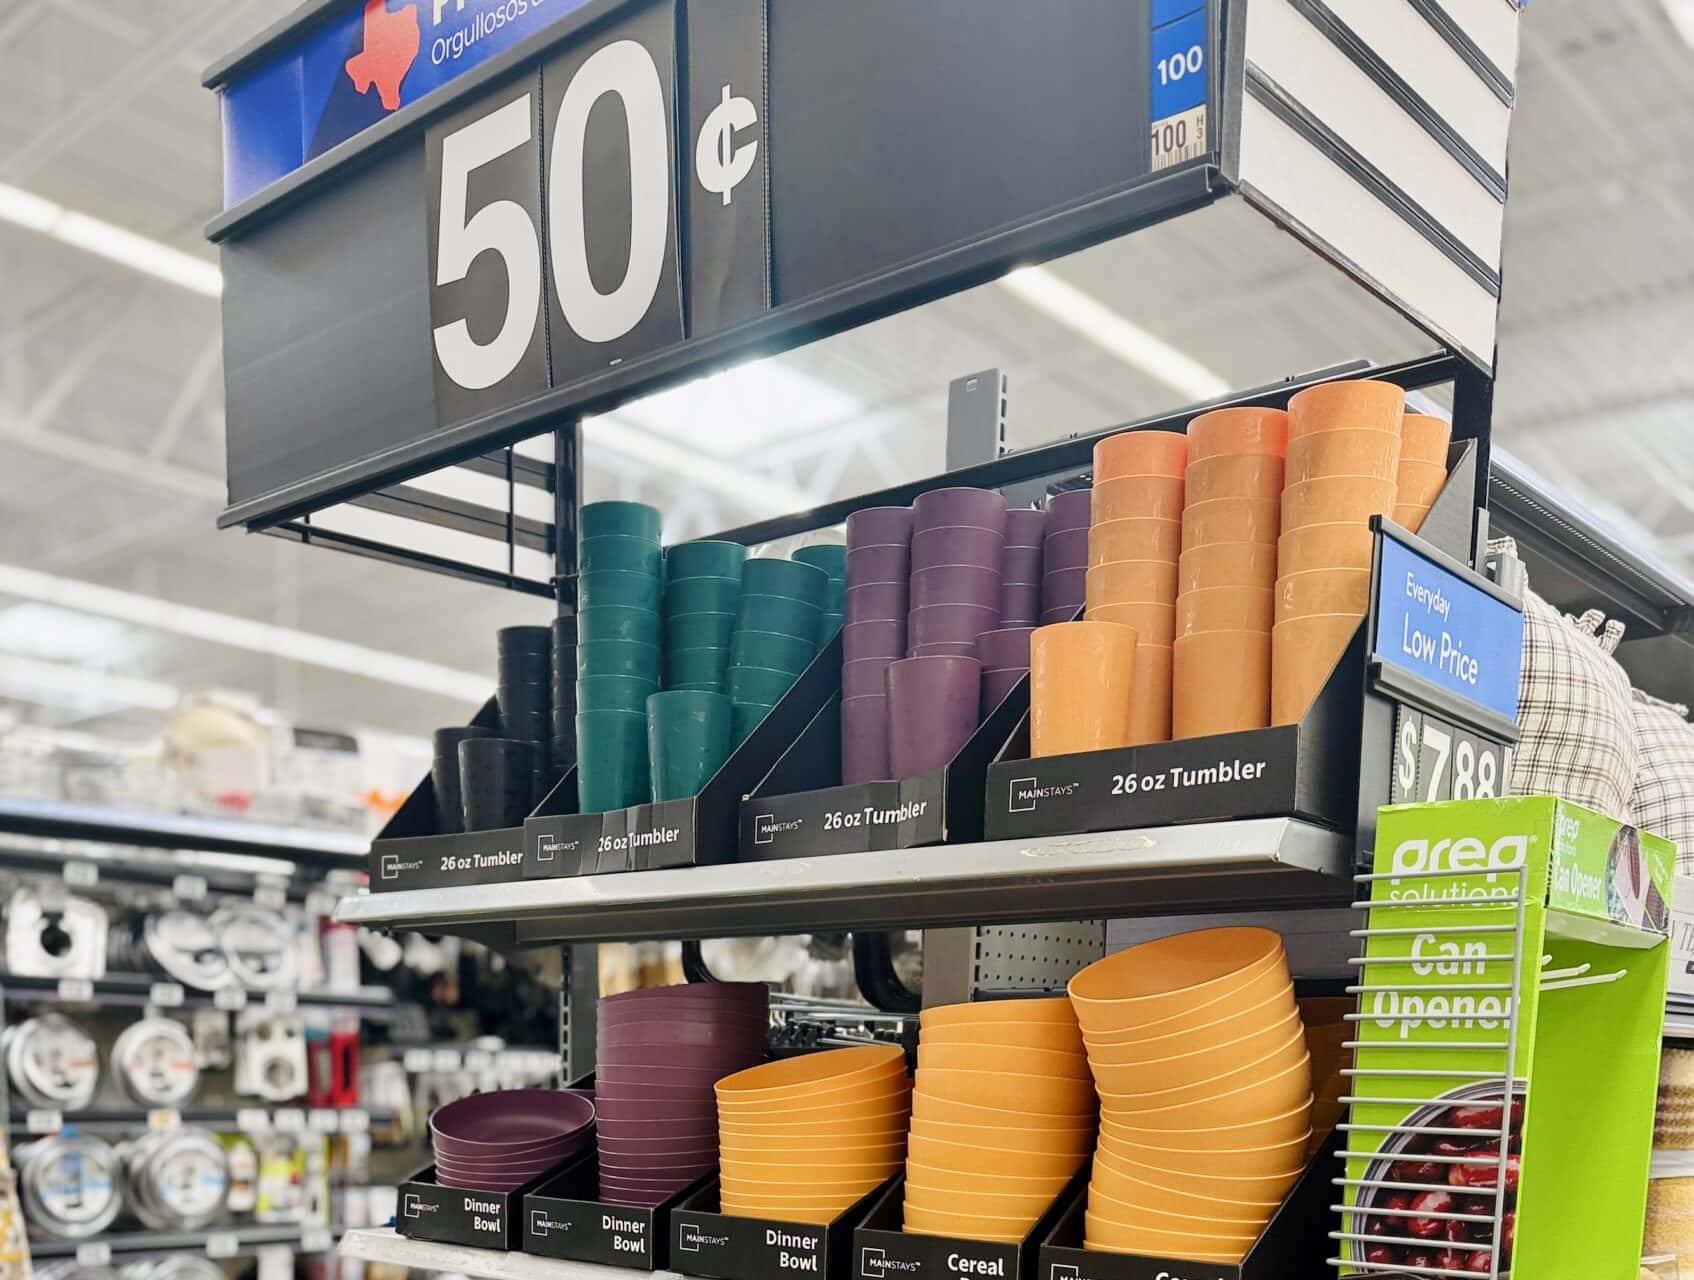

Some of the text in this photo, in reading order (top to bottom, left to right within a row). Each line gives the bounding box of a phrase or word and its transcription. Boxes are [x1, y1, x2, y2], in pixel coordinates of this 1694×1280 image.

[431, 0, 528, 65] Orgullosos
[1157, 45, 1203, 86] 100
[1151, 120, 1186, 156] 100
[1406, 571, 1451, 622] Everyday
[1403, 612, 1479, 685] Low Price
[1111, 759, 1266, 795] 26 oz Tumbler
[1018, 784, 1073, 800] MAINSTAYS
[824, 800, 927, 831] 26 oz Tumbler
[598, 828, 680, 853] 26 oz Tumbler
[440, 851, 523, 871] 26 oz Tumbler
[1390, 835, 1528, 885] prep
[1410, 933, 1487, 976] Can
[1373, 990, 1520, 1038] Opener
[464, 1198, 500, 1214] Dinner
[474, 1216, 501, 1232] Bowl
[602, 1215, 645, 1234] Dinner
[614, 1235, 645, 1253] Bowl
[766, 1229, 818, 1250] Dinner
[779, 1252, 818, 1272] Bowl
[869, 1258, 916, 1272] MAINSTAYS
[948, 1254, 1004, 1277] Cereal
